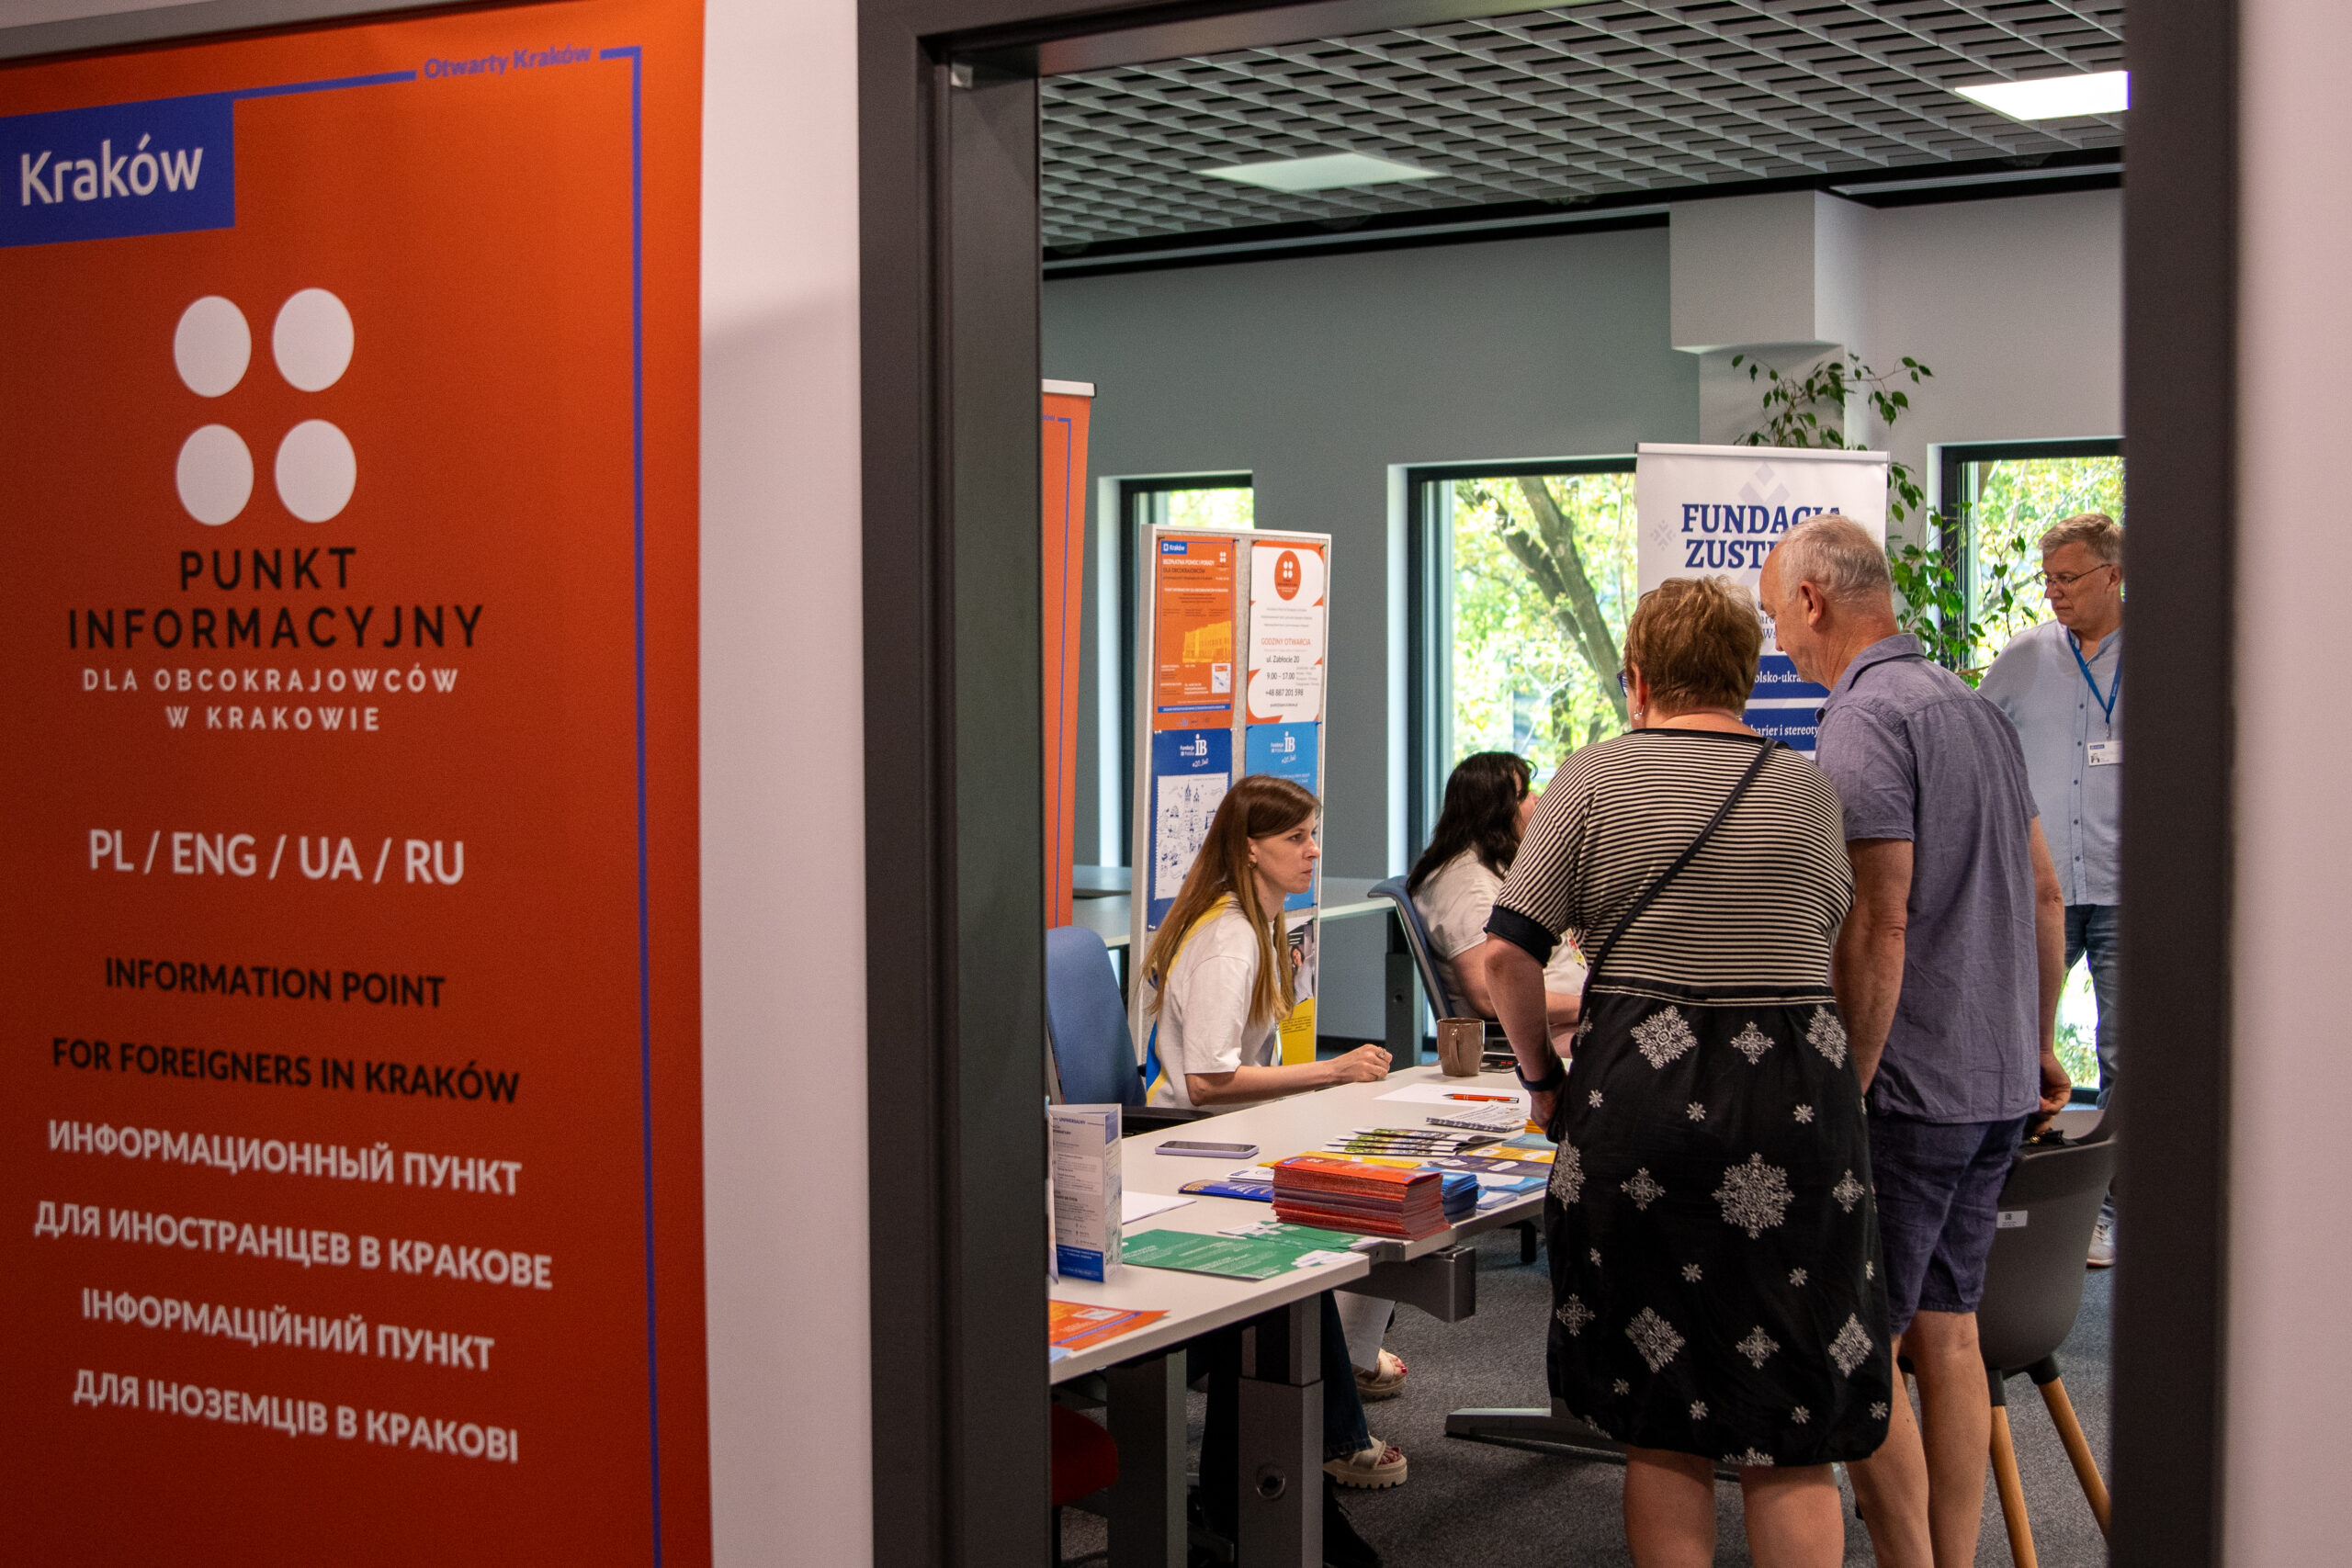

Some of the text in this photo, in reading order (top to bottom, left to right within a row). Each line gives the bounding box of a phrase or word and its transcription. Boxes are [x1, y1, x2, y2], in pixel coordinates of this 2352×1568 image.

[424, 44, 593, 80] Otwarty Kraków
[21, 133, 204, 206] Kraków
[1681, 503, 1840, 534] FUNDAC
[179, 547, 356, 592] PUNKT
[67, 605, 483, 650] INFORMACYJNY
[1261, 637, 1283, 646] GODZINY
[83, 662, 458, 694] DLA OBCOKRAJOWCÓW
[1755, 671, 1804, 683] olsko-ukra
[165, 705, 379, 731] W KRAKOWIE
[1780, 724, 1783, 736] i
[90, 829, 465, 886] PL / ENG / UA / RU
[105, 956, 446, 1008] INFORMATION POINT
[51, 1036, 520, 1103] FOR FOREIGNERS IN KRAKÓW
[49, 1120, 523, 1196] ИНФОРМАЦИОННЫЙ ПУНКТ
[34, 1201, 553, 1290] ДЛЯ ИНОСТРАНЦЕВ В КРАКОВЕ
[83, 1288, 495, 1371] ІНФОРМАЦІЙНИЙ ПУНКТ
[73, 1369, 518, 1463] ДЛЯ ІНОЗЕМЦІВ В КРАКОВІ
